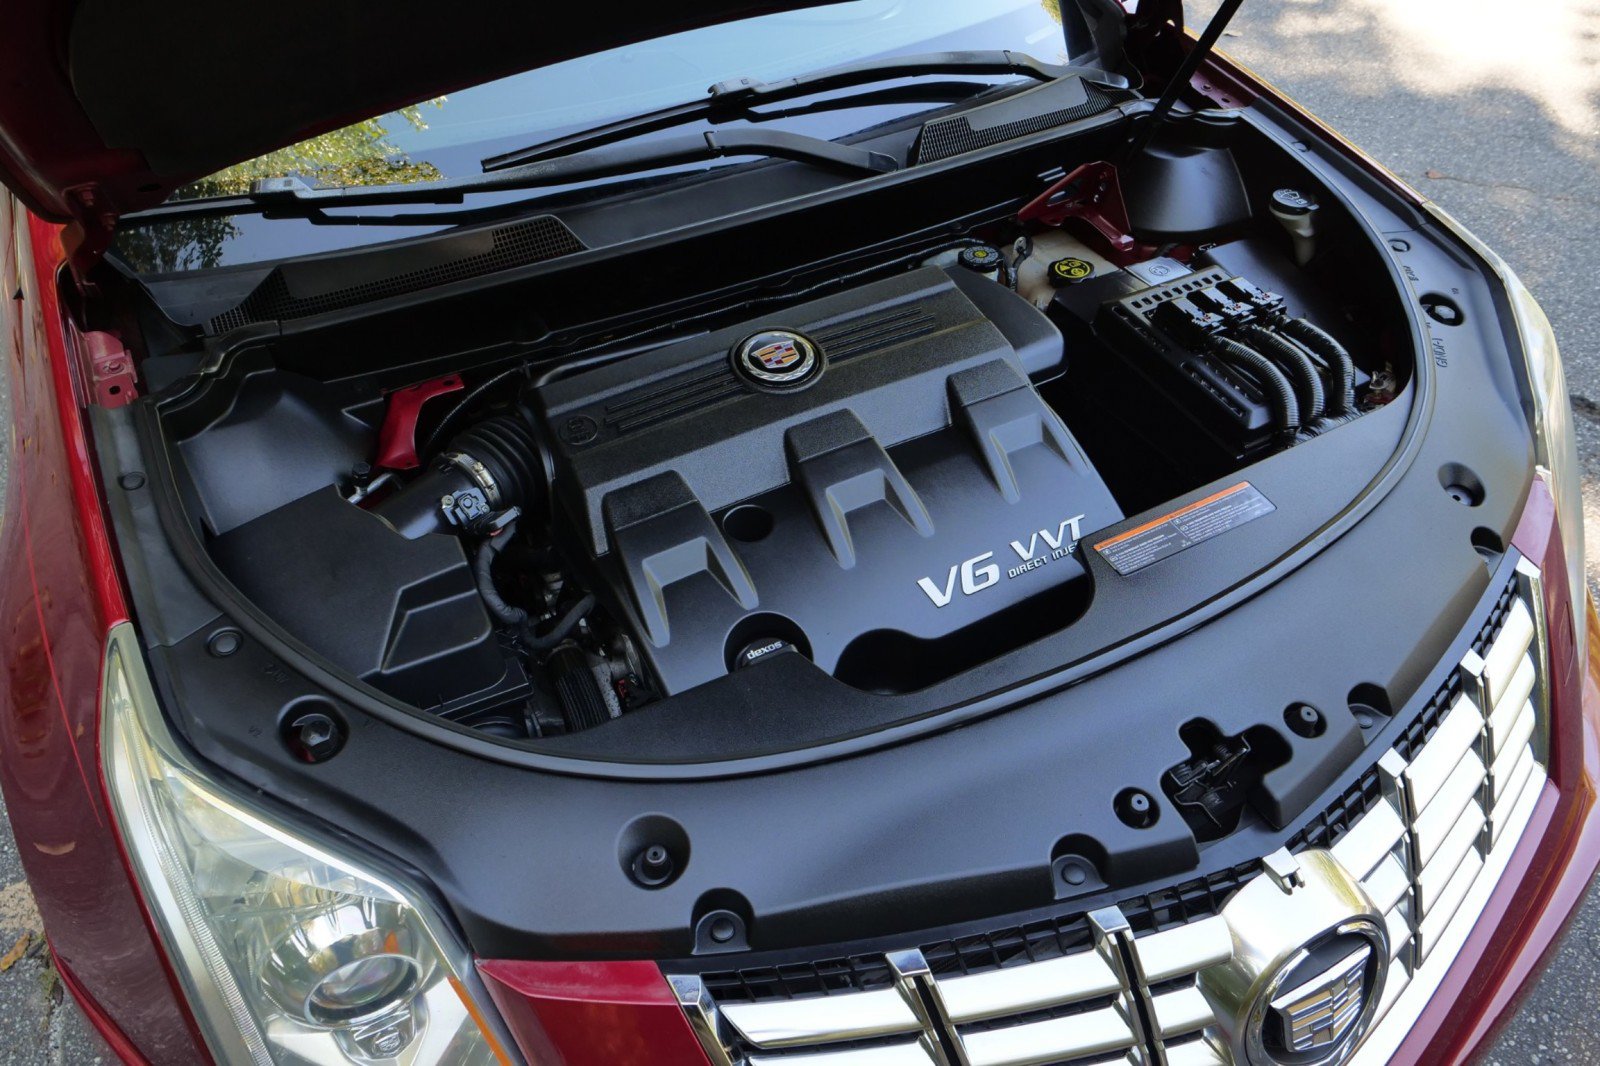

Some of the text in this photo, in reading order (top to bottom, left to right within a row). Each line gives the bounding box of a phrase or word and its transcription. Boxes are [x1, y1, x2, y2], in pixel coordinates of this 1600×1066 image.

[917, 551, 1000, 608] V6
[1009, 513, 1085, 562] VVT
[1008, 555, 1048, 579] DIRECT
[746, 641, 783, 660] dexos
